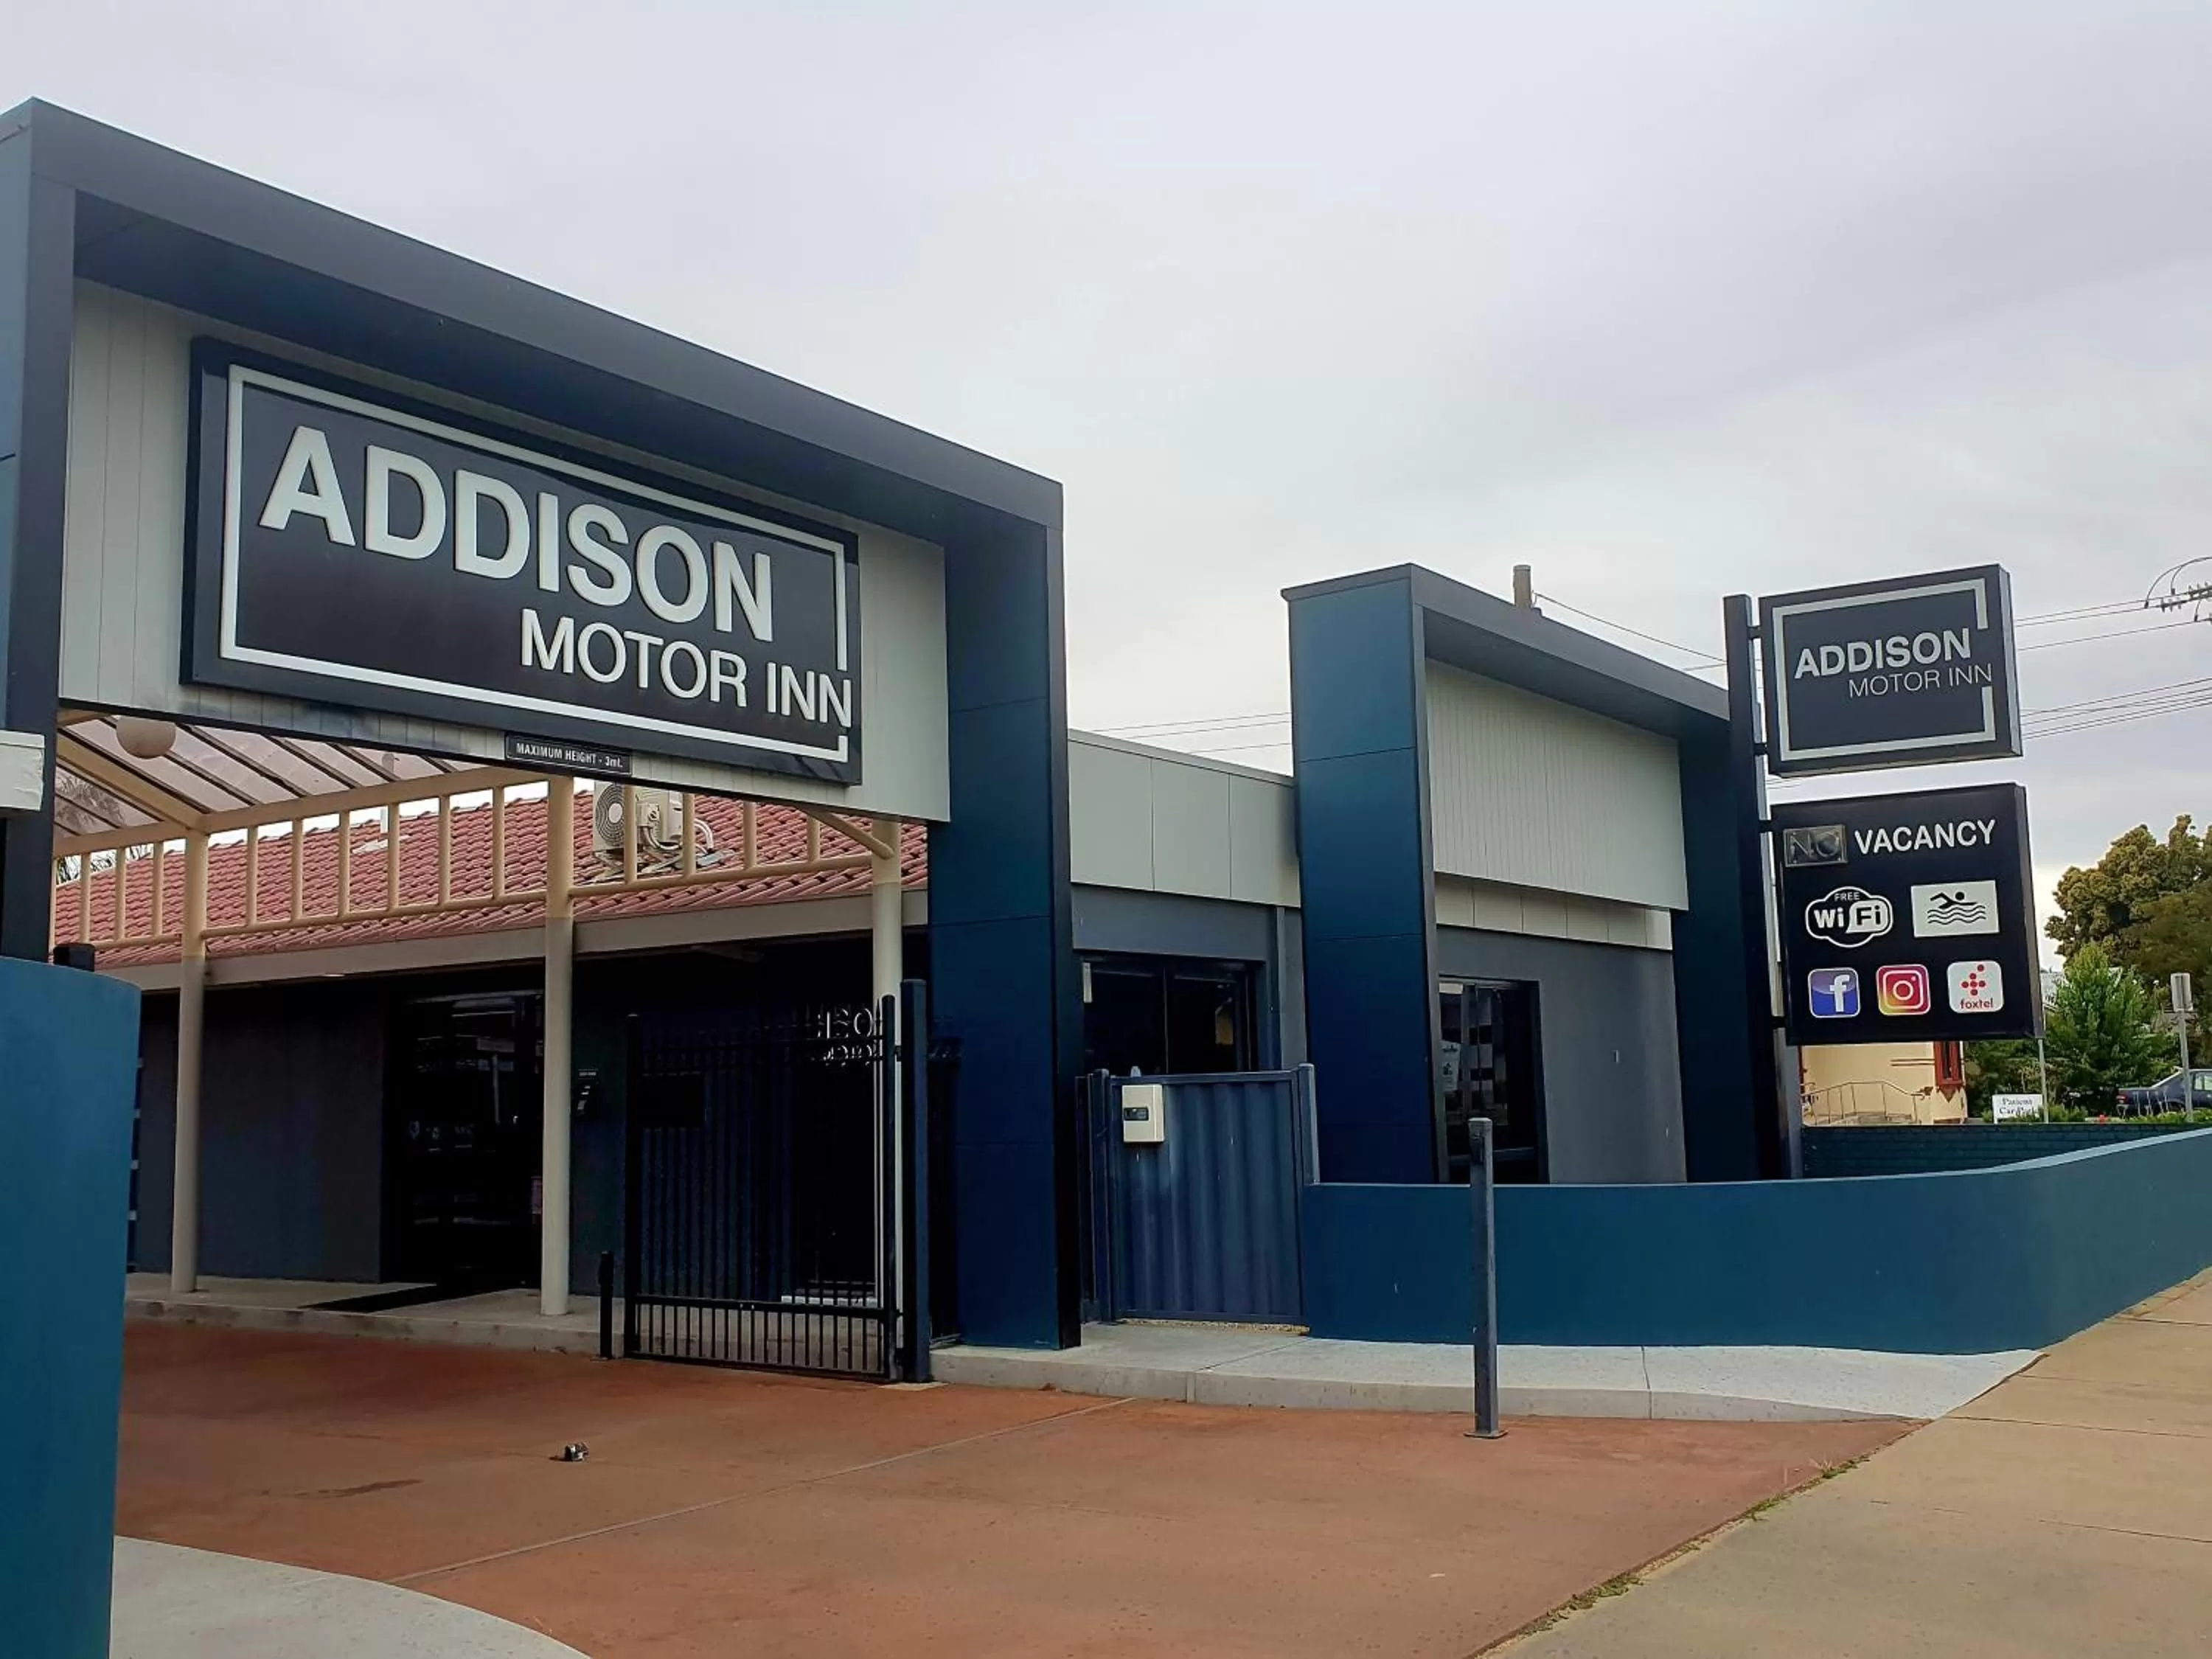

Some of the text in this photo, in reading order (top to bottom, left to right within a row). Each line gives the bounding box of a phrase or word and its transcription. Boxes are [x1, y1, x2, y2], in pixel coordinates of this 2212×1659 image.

[259, 425, 773, 642] ADDISON
[521, 607, 853, 728] MOTOR INN
[1794, 627, 1972, 679] ADDISON
[1848, 663, 1992, 698] MOTOR INN
[516, 742, 563, 759] MAXIMUM
[565, 748, 597, 764] HEIGHT
[1790, 819, 1996, 860] NO VACANCY
[1834, 891, 1860, 901] FREE
[1960, 997, 1994, 1009] foxtel
